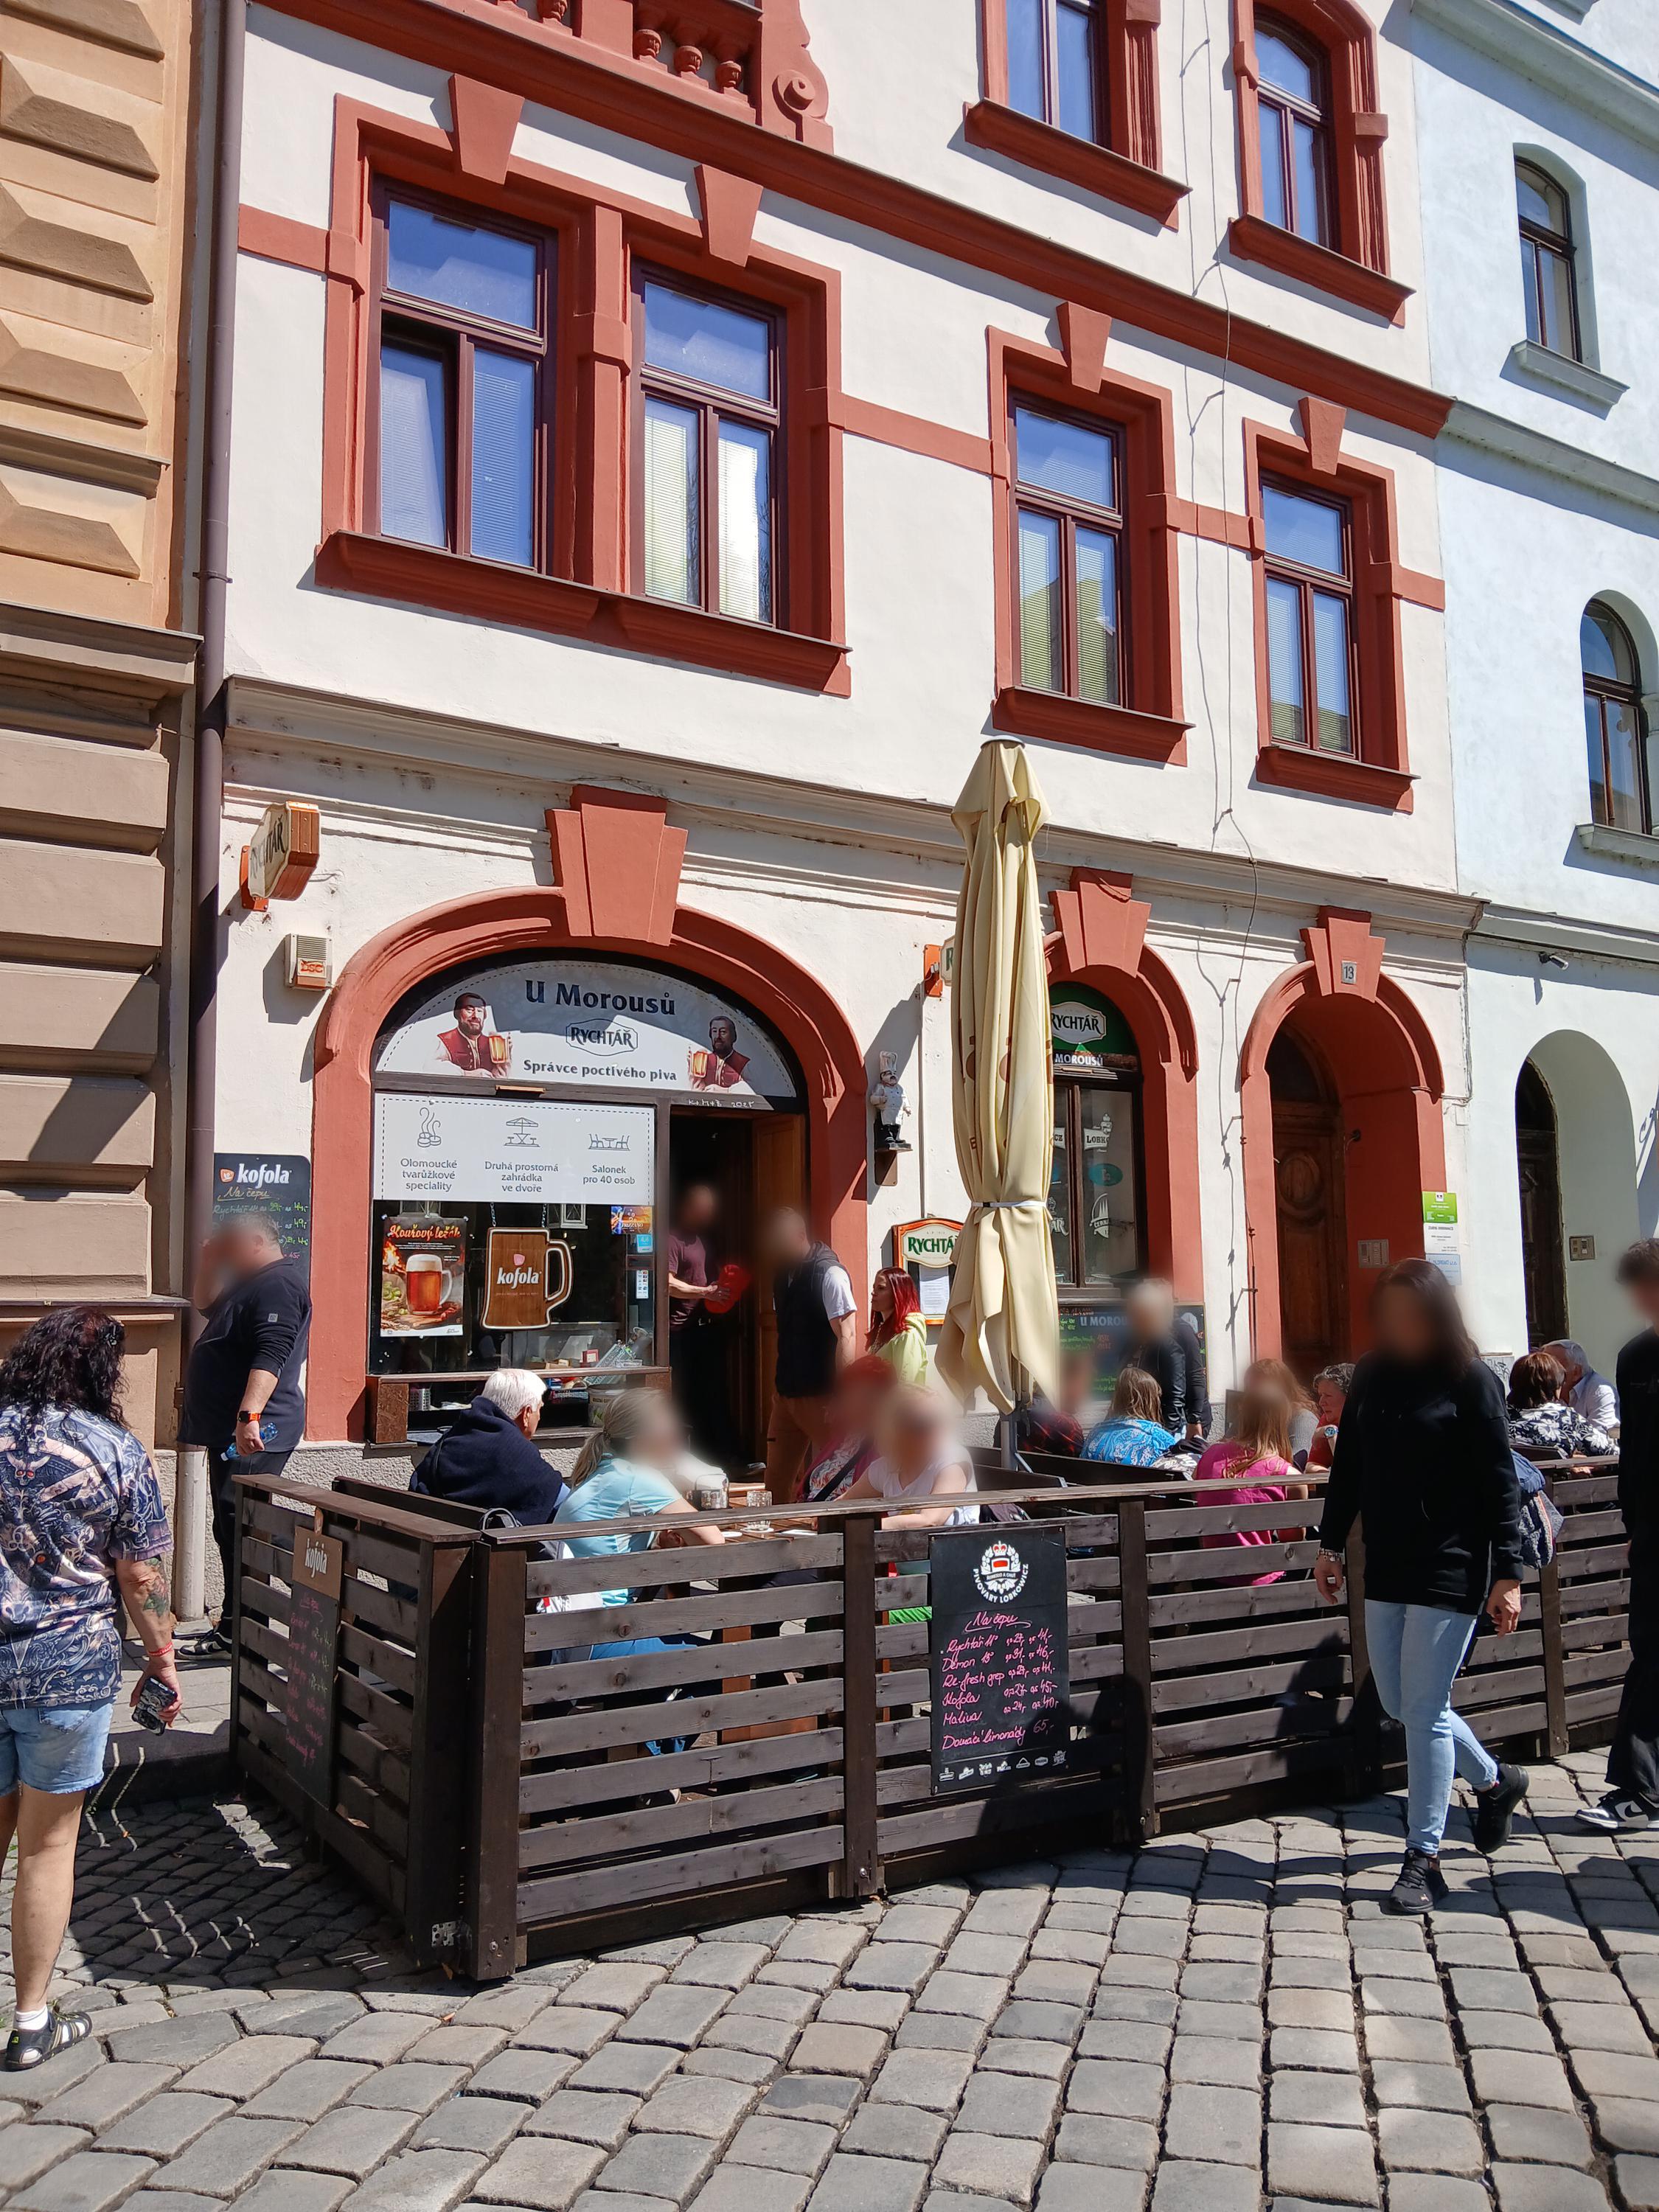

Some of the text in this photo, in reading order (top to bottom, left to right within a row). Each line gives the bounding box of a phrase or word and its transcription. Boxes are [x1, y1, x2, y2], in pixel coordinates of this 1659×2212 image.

[1343, 966, 1354, 979] 13
[525, 979, 675, 1015] U Morousů
[570, 1026, 637, 1050] RYCHTÁŘ
[1055, 1054, 1103, 1066] MOROUSŮ
[524, 1059, 578, 1074] Správce
[650, 1070, 677, 1082] piva
[400, 1158, 457, 1169] Olomoucké
[484, 1161, 559, 1173] Druhá prostorná
[592, 1165, 626, 1174] Salonek
[237, 1164, 290, 1189] kofola
[403, 1169, 456, 1180] tvarůžkové
[501, 1173, 543, 1182] zahrádka
[582, 1175, 636, 1185] pro 40 osob
[406, 1182, 452, 1192] speciality
[515, 1184, 542, 1192] dvoře
[908, 1235, 959, 1256] RYCHTÁ
[497, 1267, 540, 1290] kofola
[305, 1537, 328, 1579] kofola
[973, 1564, 1029, 1604] PIVOVARY LOBKOWICZ
[973, 1611, 992, 1626] Na
[947, 1635, 984, 1661] Rychtář
[987, 1672, 1005, 1687] grep
[942, 1691, 981, 1710] Kofola
[943, 1711, 983, 1726] Malina
[942, 1719, 1054, 1750] Domácí limonády 65,-
